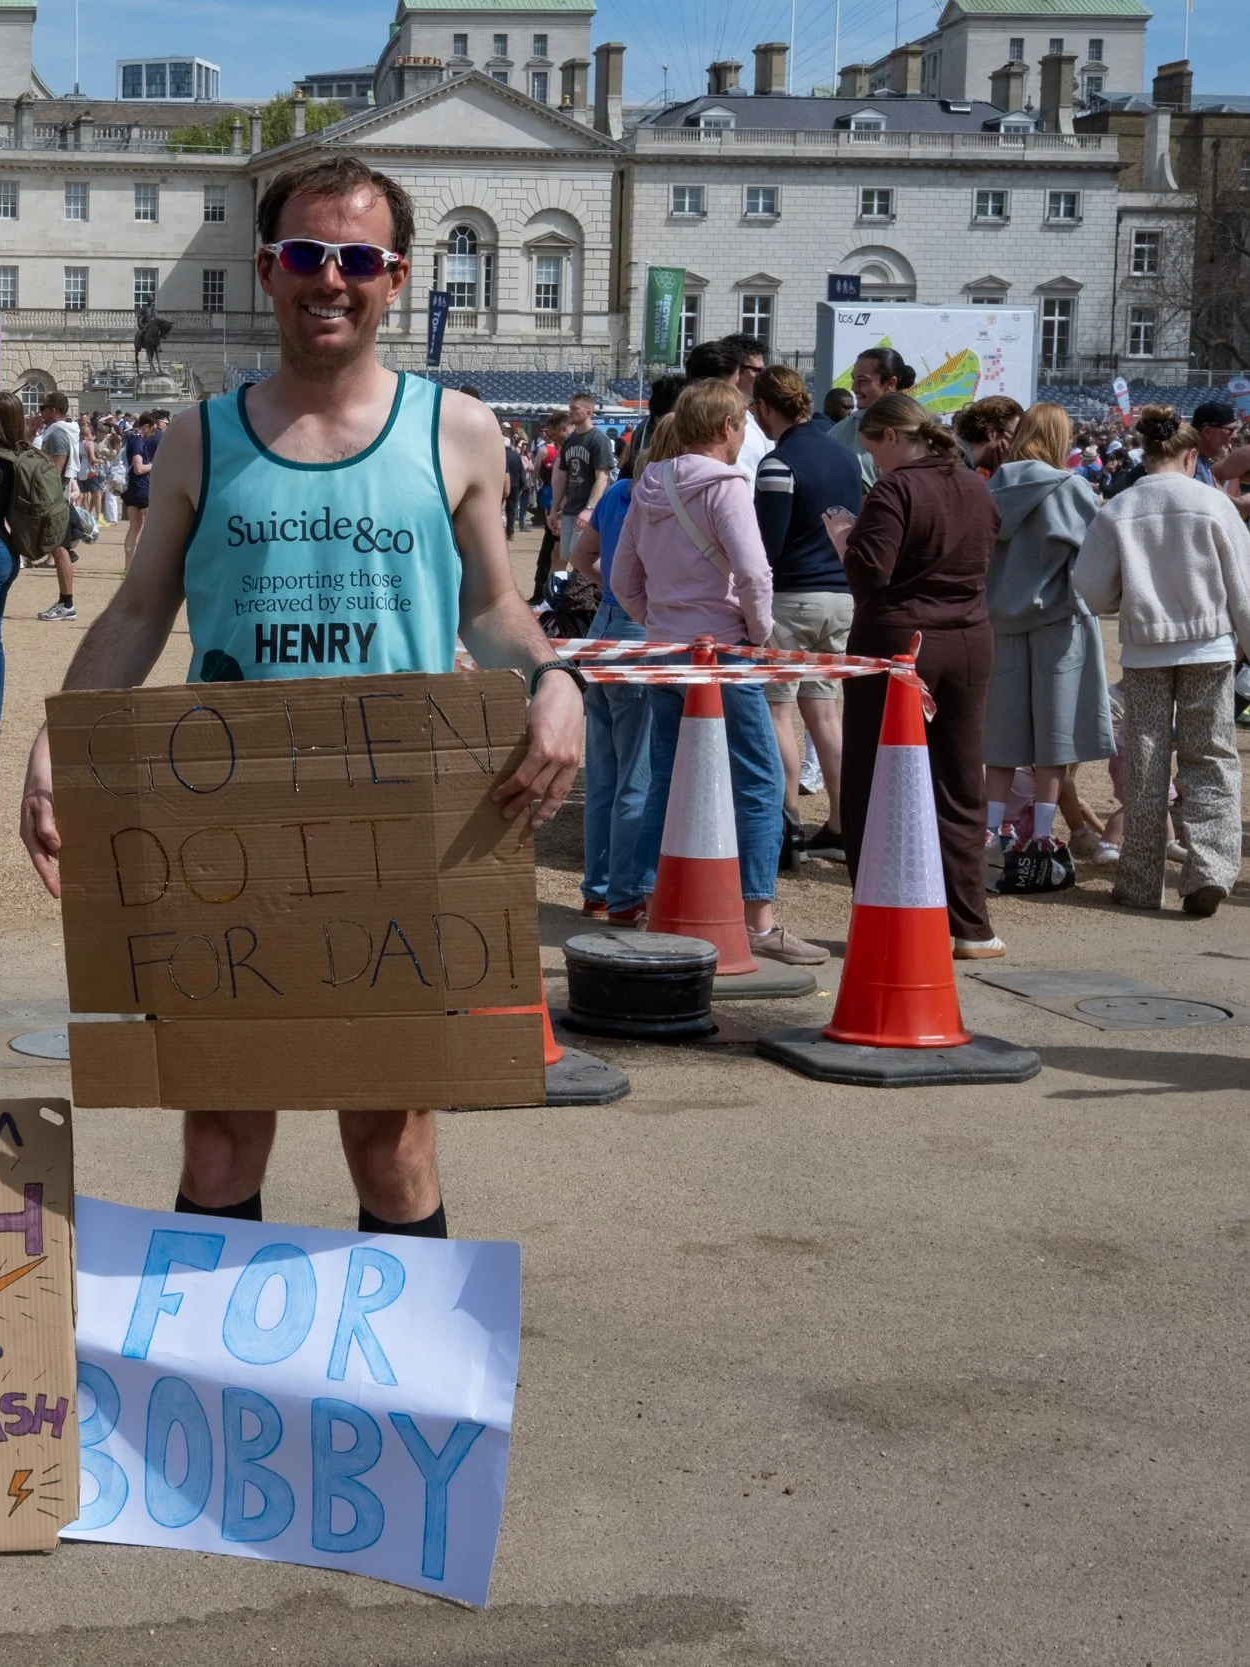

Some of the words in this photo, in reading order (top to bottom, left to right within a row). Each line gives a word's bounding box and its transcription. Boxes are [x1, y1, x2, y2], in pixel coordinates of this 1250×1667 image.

[838, 312, 854, 324] tcs
[227, 506, 414, 555] Suicide&co
[234, 593, 313, 616] breaved
[318, 593, 342, 615] by
[346, 592, 412, 613] suicide
[241, 570, 344, 594] Supporting
[350, 569, 402, 589] those
[255, 622, 378, 664] HENRY
[88, 705, 236, 796] GO
[284, 692, 494, 793] HEN
[110, 826, 248, 907] DO
[281, 818, 411, 897] IT
[1015, 857, 1031, 887] M&S
[128, 926, 284, 1004] FOR
[322, 908, 518, 991] DAD!
[121, 1228, 406, 1386] FOR
[76, 1361, 486, 1581] BOBBY
